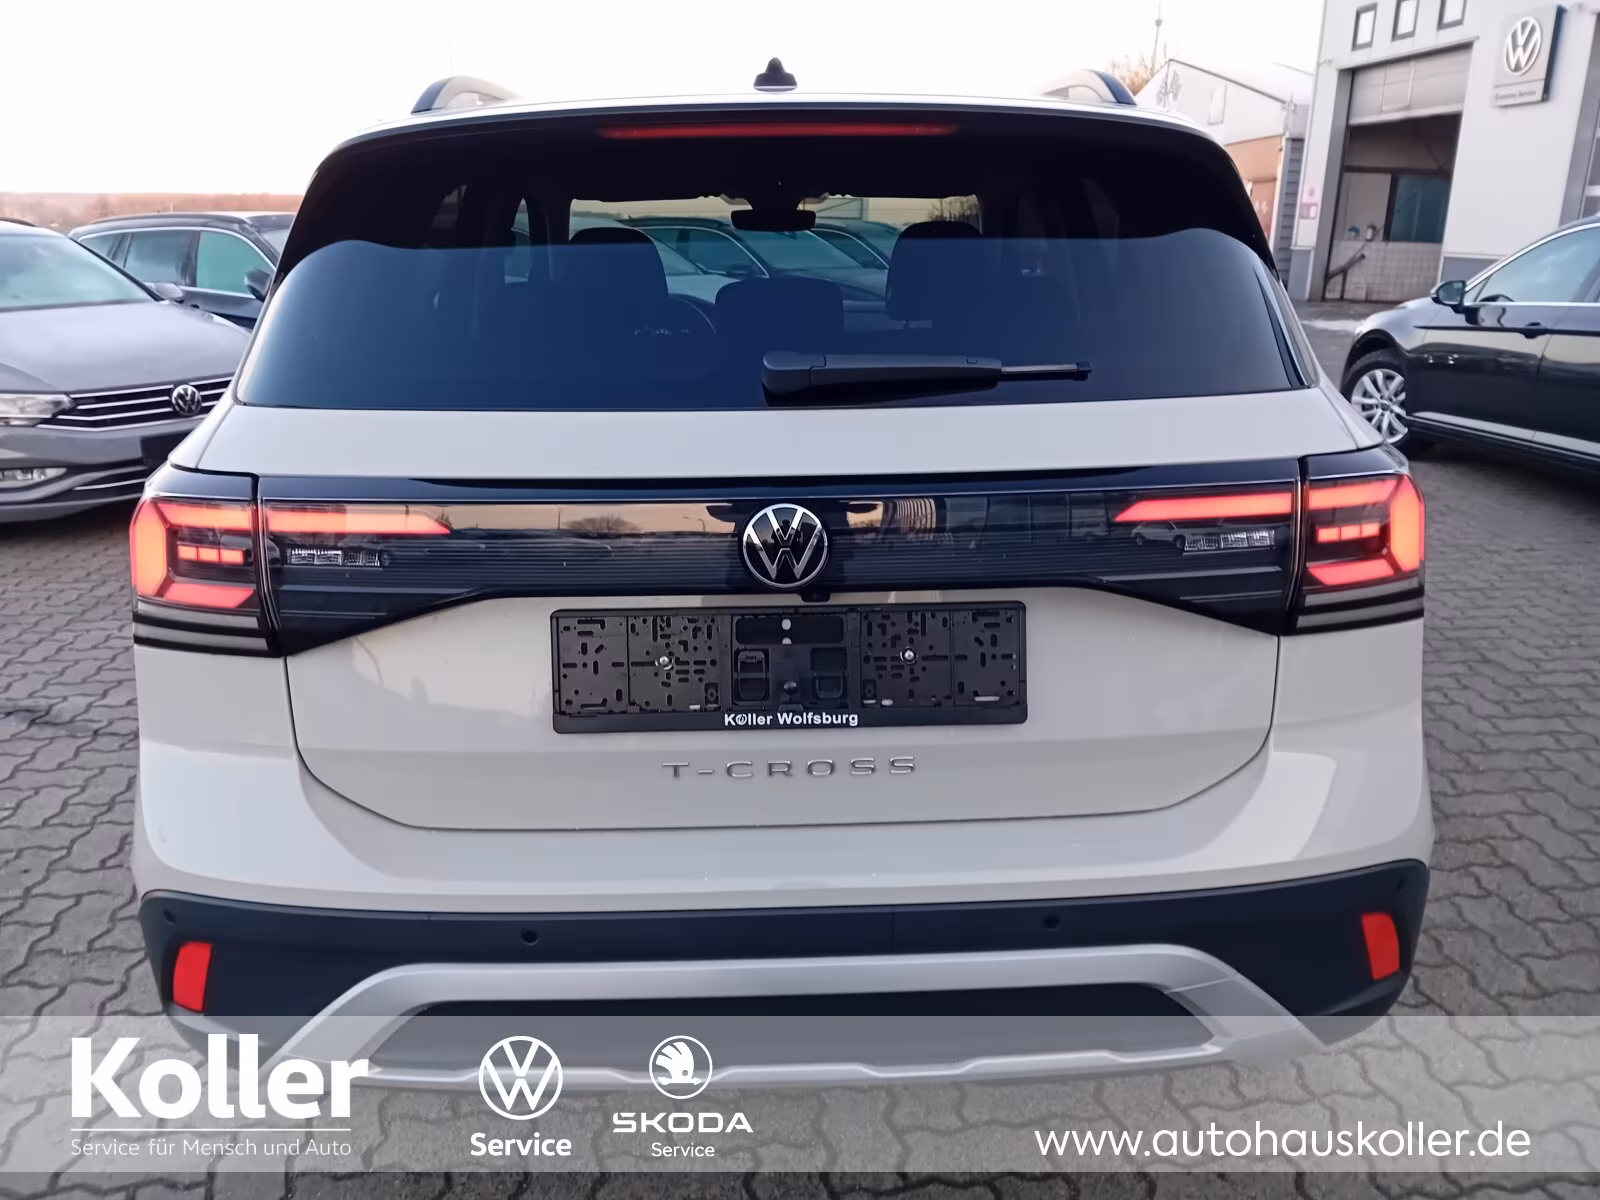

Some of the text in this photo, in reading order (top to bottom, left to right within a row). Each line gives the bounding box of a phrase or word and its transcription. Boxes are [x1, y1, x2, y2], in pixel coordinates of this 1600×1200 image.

[742, 503, 828, 588] VW
[724, 712, 859, 727] Koller Wolfsburg
[662, 756, 916, 779] T-CROSS
